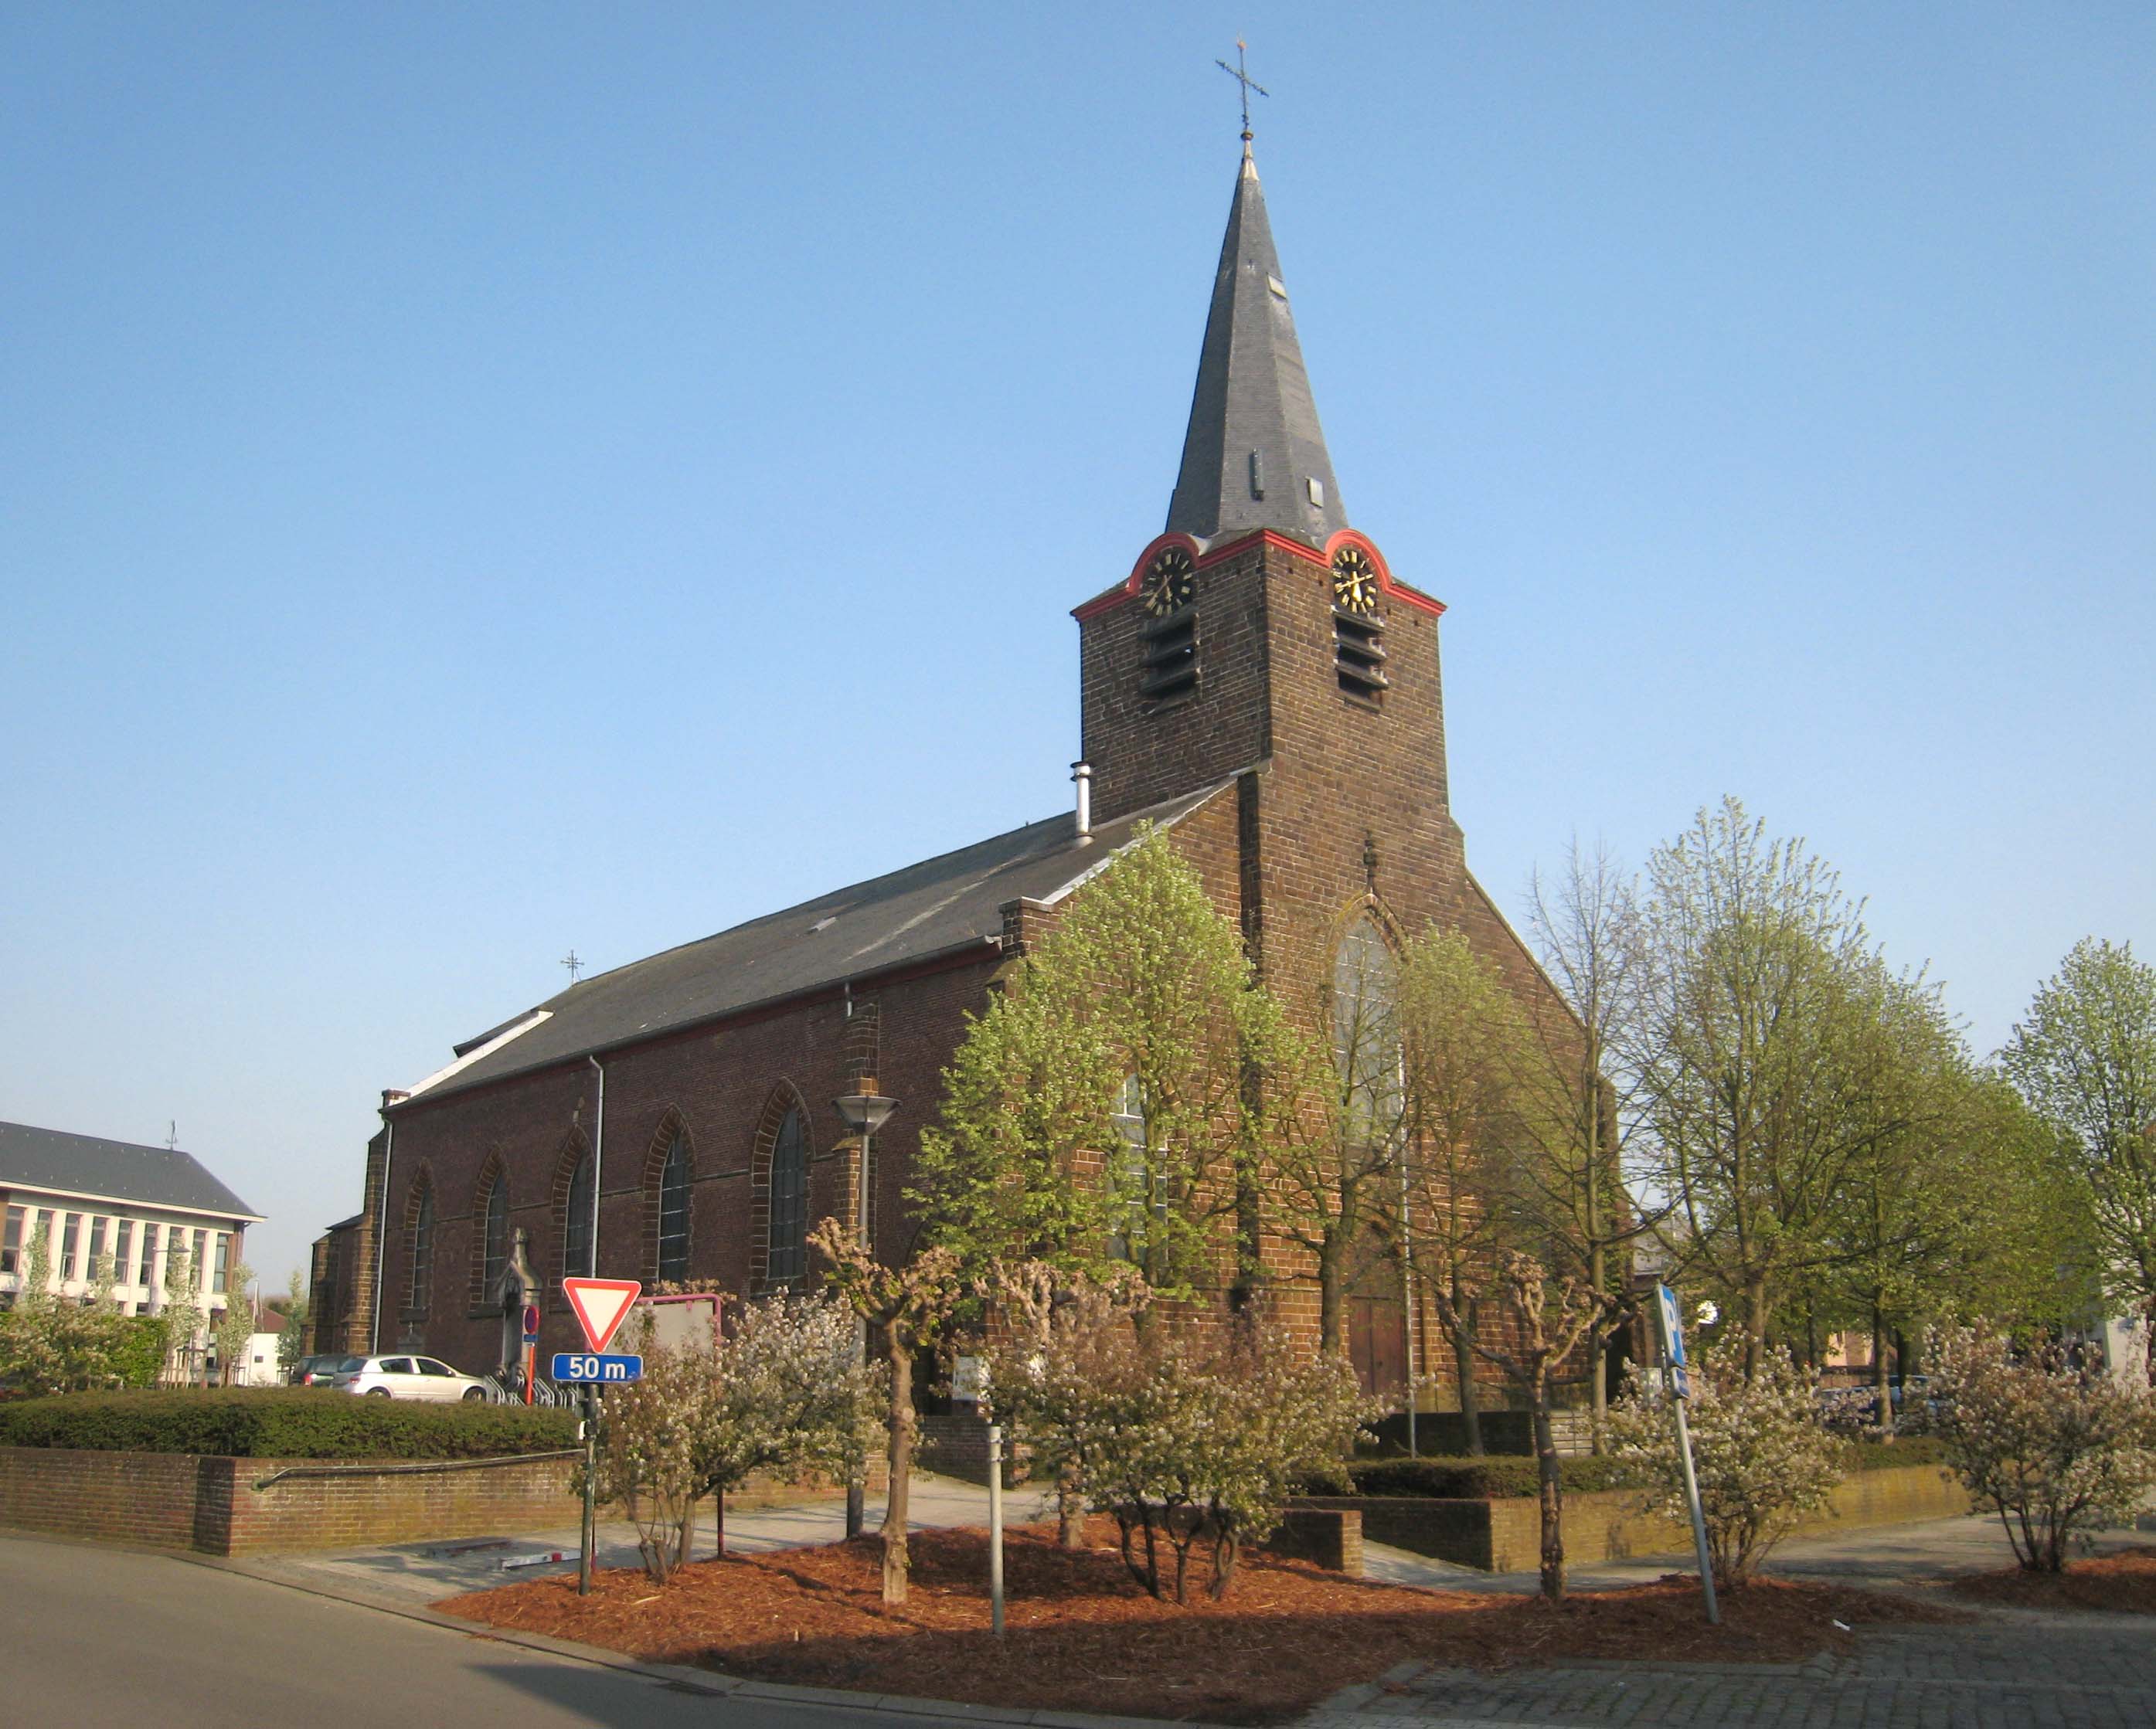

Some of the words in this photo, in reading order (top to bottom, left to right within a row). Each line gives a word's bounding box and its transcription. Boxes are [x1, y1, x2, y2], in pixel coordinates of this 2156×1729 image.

[1665, 1299, 1677, 1351] P
[570, 1357, 599, 1379] 50
[605, 1363, 625, 1379] m
